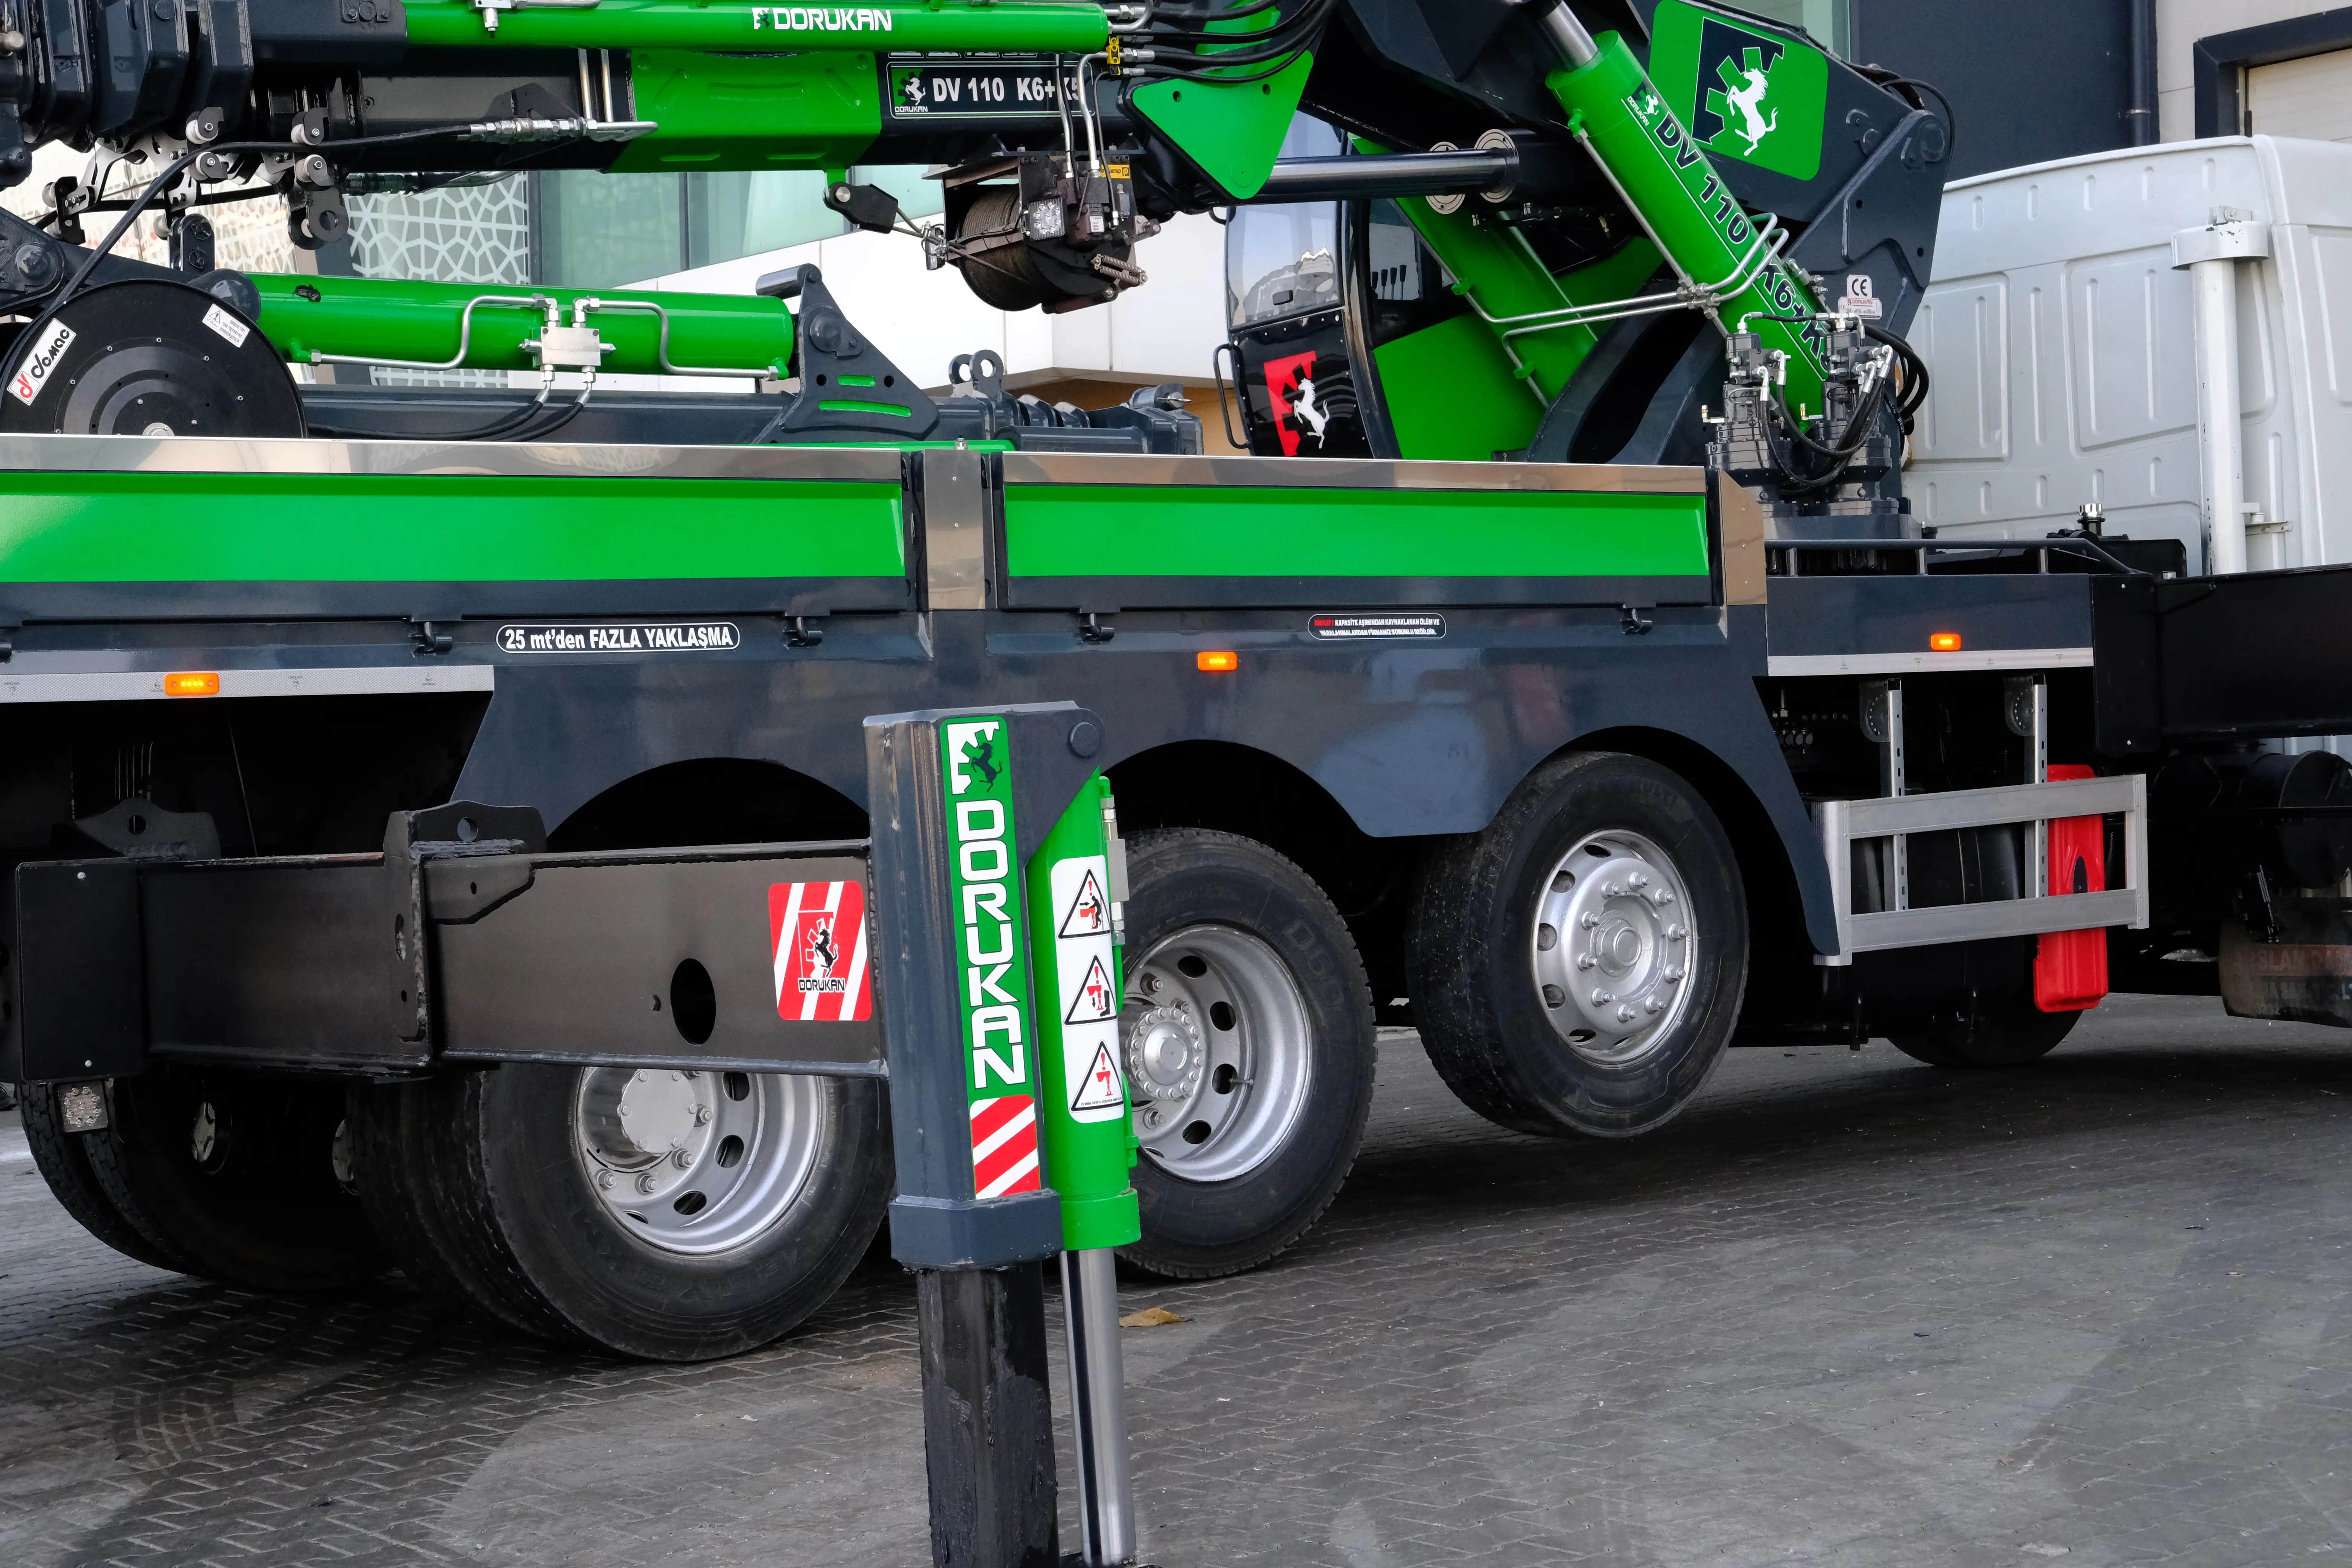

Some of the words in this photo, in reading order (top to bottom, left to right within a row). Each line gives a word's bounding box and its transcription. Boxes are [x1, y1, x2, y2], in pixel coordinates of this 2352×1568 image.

[772, 8, 892, 31] DORUKAN
[933, 78, 960, 101] DV
[968, 77, 1004, 101] 110
[1627, 95, 1650, 126] DORUKAN
[1654, 110, 1702, 170] DV
[1699, 173, 1749, 244] 110
[1852, 278, 1868, 297] CE
[1335, 618, 1358, 626] KAPASİTE
[1358, 619, 1385, 627] AŞIMINDAN
[505, 629, 525, 649] 25
[530, 629, 585, 649] mt'den
[590, 629, 642, 648] FAZLA
[644, 626, 733, 649] YAKLAŞMA
[956, 798, 1026, 1089] DORUKAN
[799, 978, 845, 992] DORUKAN
